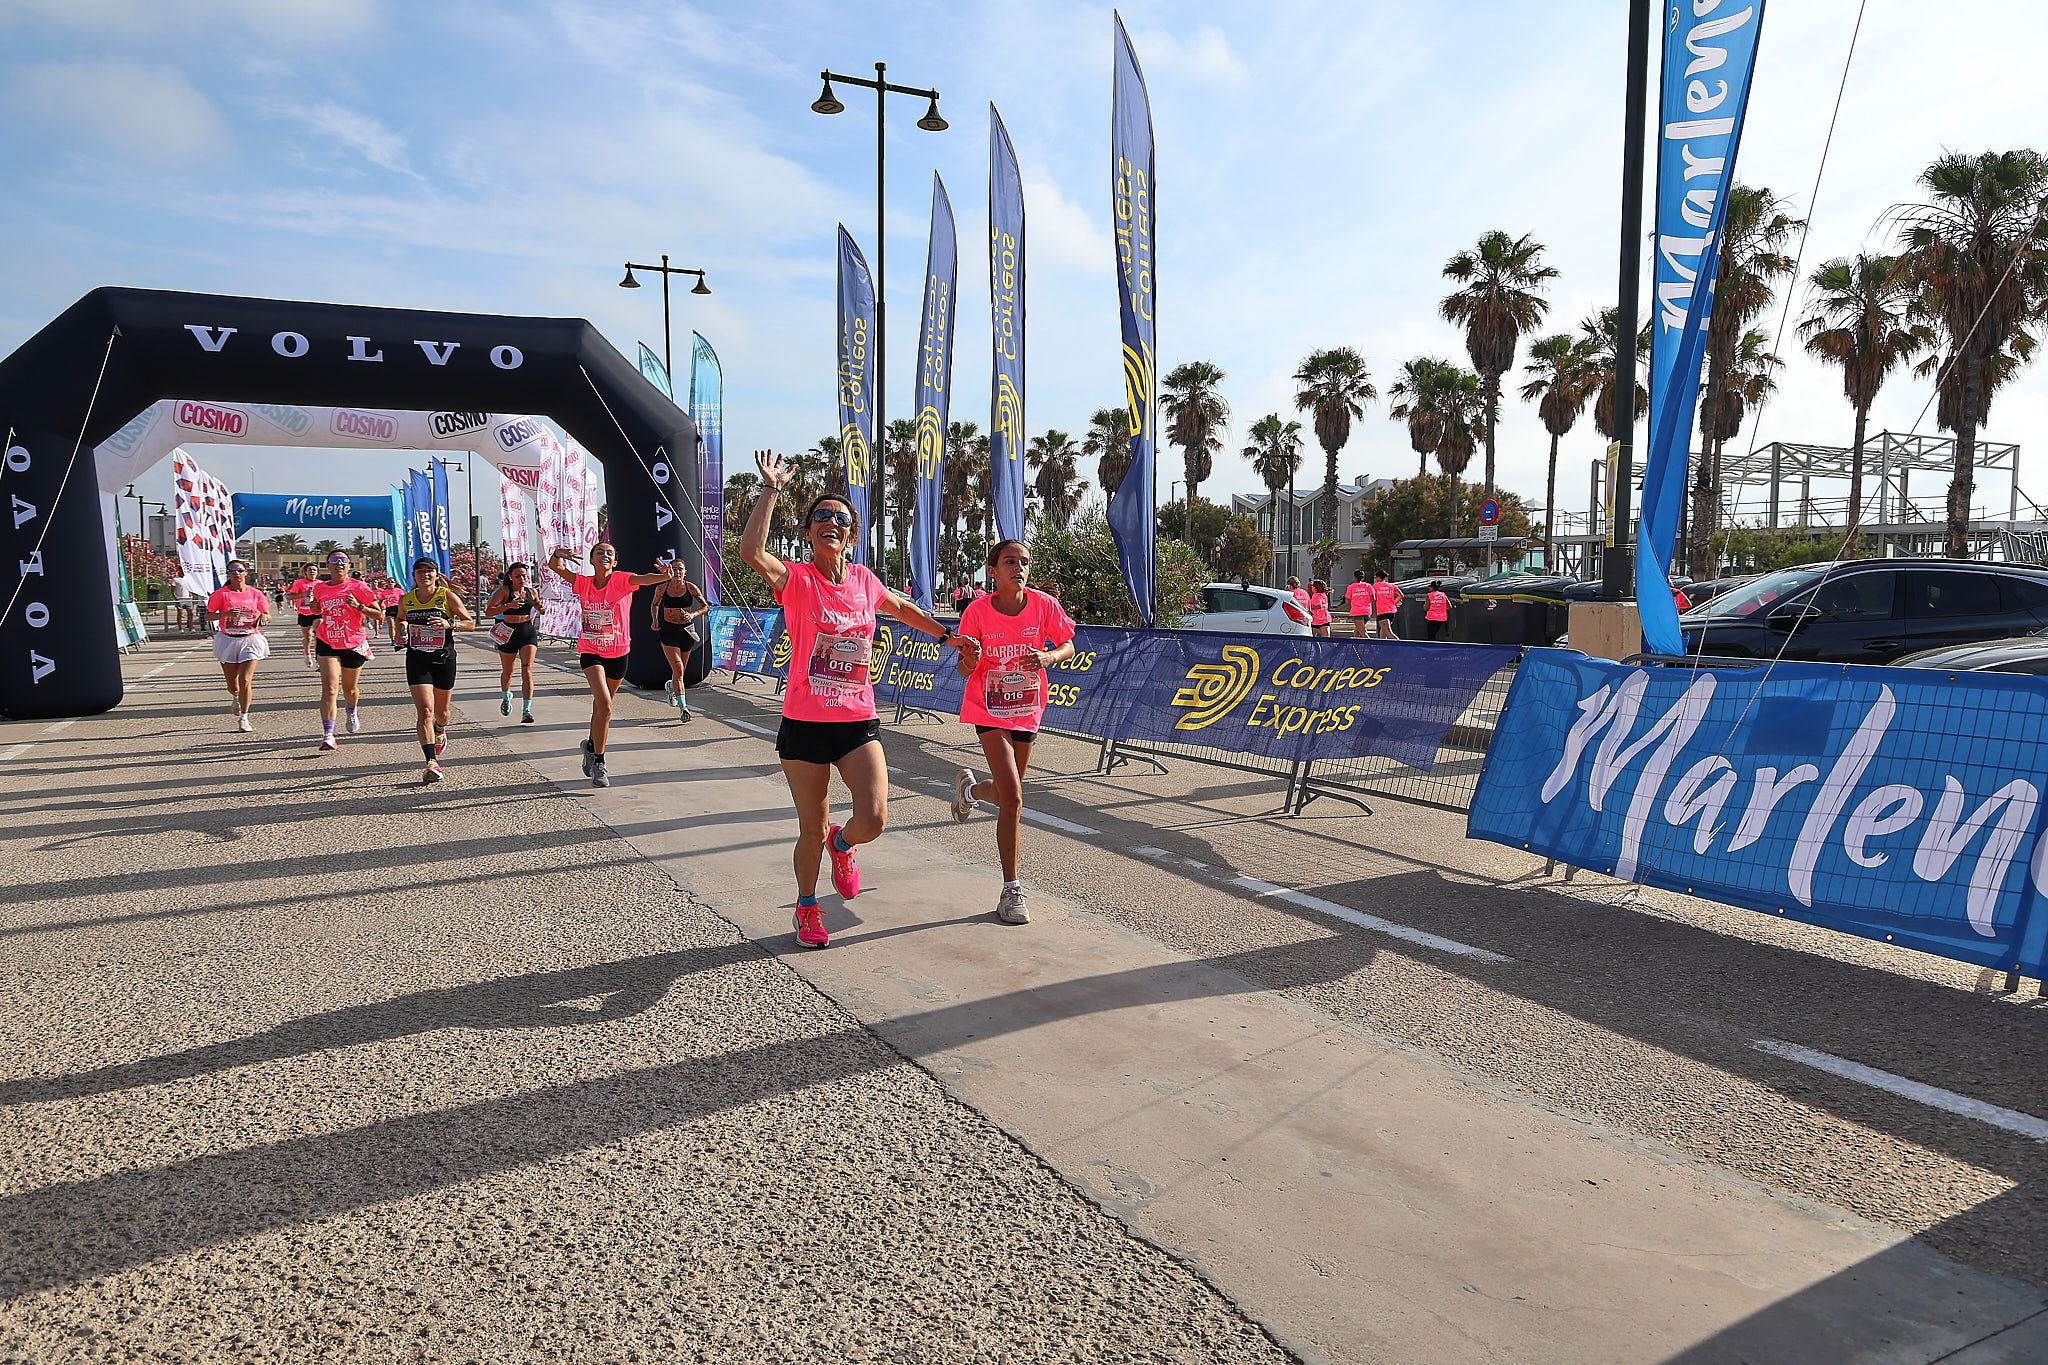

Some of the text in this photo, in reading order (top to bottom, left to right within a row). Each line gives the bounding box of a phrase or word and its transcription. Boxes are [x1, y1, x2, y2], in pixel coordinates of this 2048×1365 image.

[184, 324, 523, 369] VOLVO
[180, 402, 243, 434] COSMO
[337, 411, 393, 439] COSMO
[434, 412, 488, 435] COSMO
[502, 466, 540, 488] COSM
[285, 497, 351, 523] Marlene
[6, 445, 56, 684] VOLVO
[896, 635, 941, 661] Correos
[829, 660, 853, 672] 016
[888, 662, 935, 692] Express
[1271, 657, 1392, 693] Correos
[1004, 691, 1024, 700] 016
[1246, 694, 1362, 740] Express
[1541, 668, 2048, 938] Marlen
